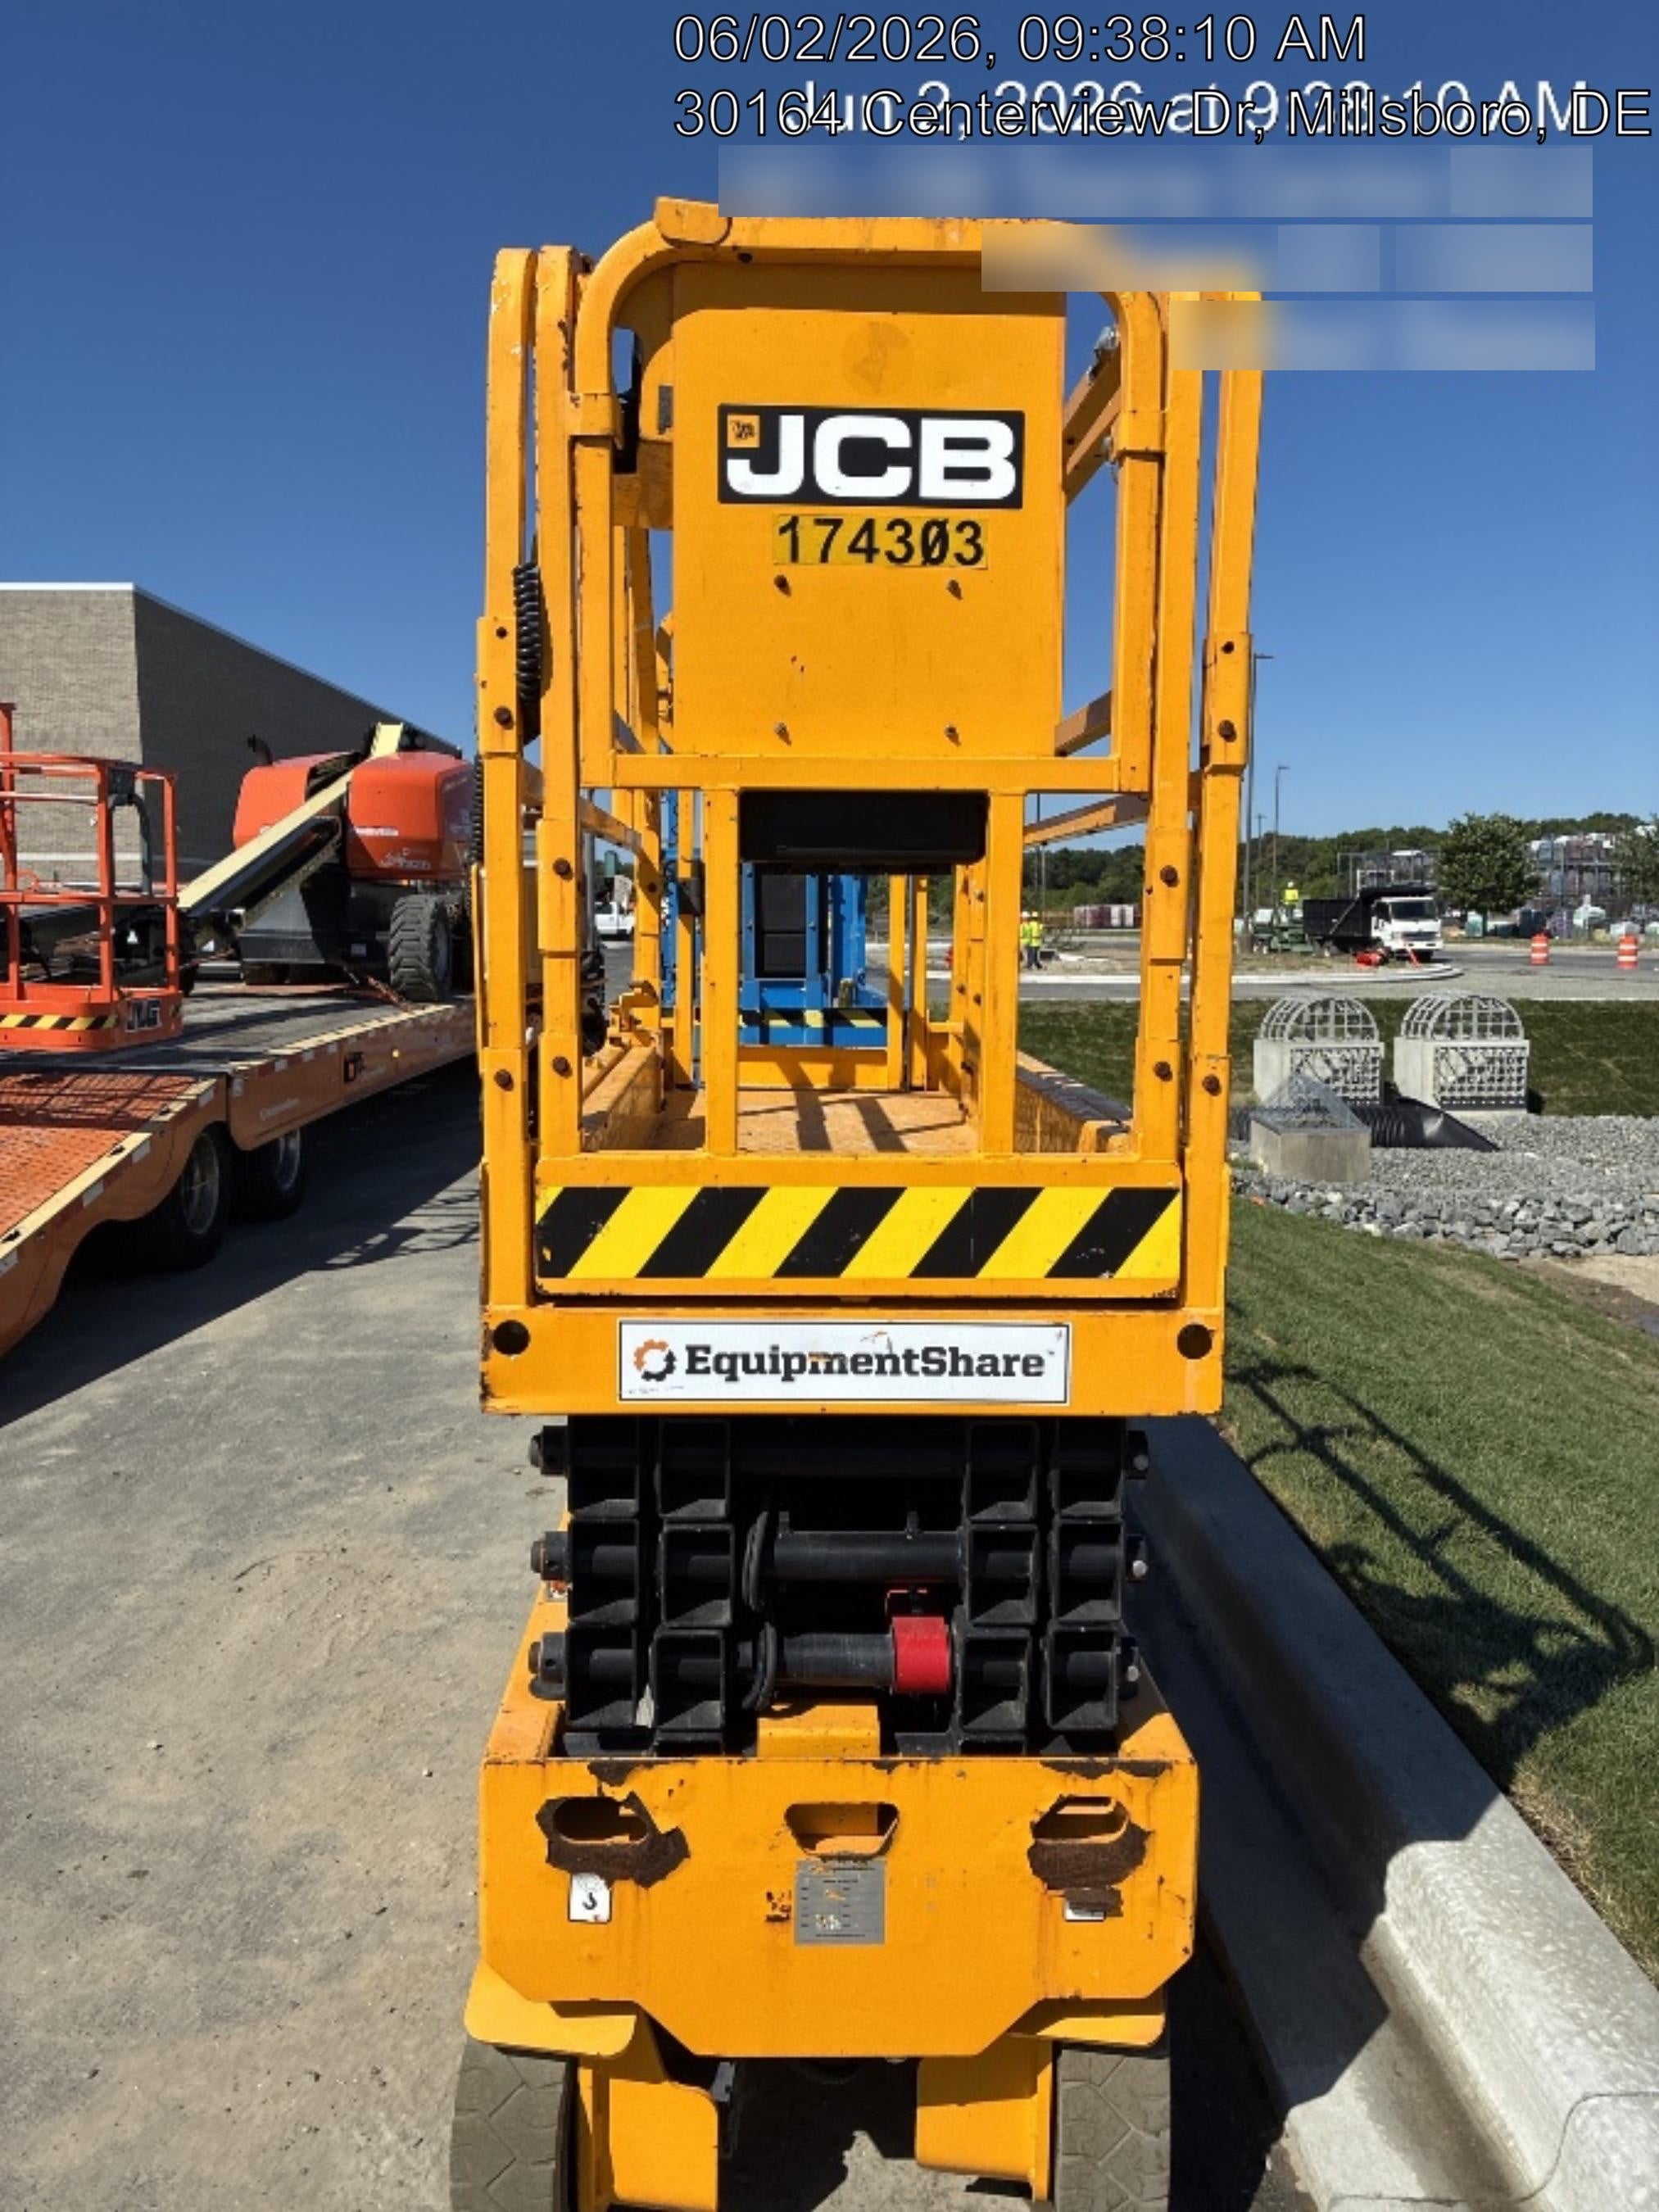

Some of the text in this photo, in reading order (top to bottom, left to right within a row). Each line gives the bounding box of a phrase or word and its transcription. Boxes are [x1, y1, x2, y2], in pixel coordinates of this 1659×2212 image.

[727, 414, 1017, 501] JCB
[778, 515, 983, 566] 174303
[685, 1344, 1045, 1382] EquipmentShare
